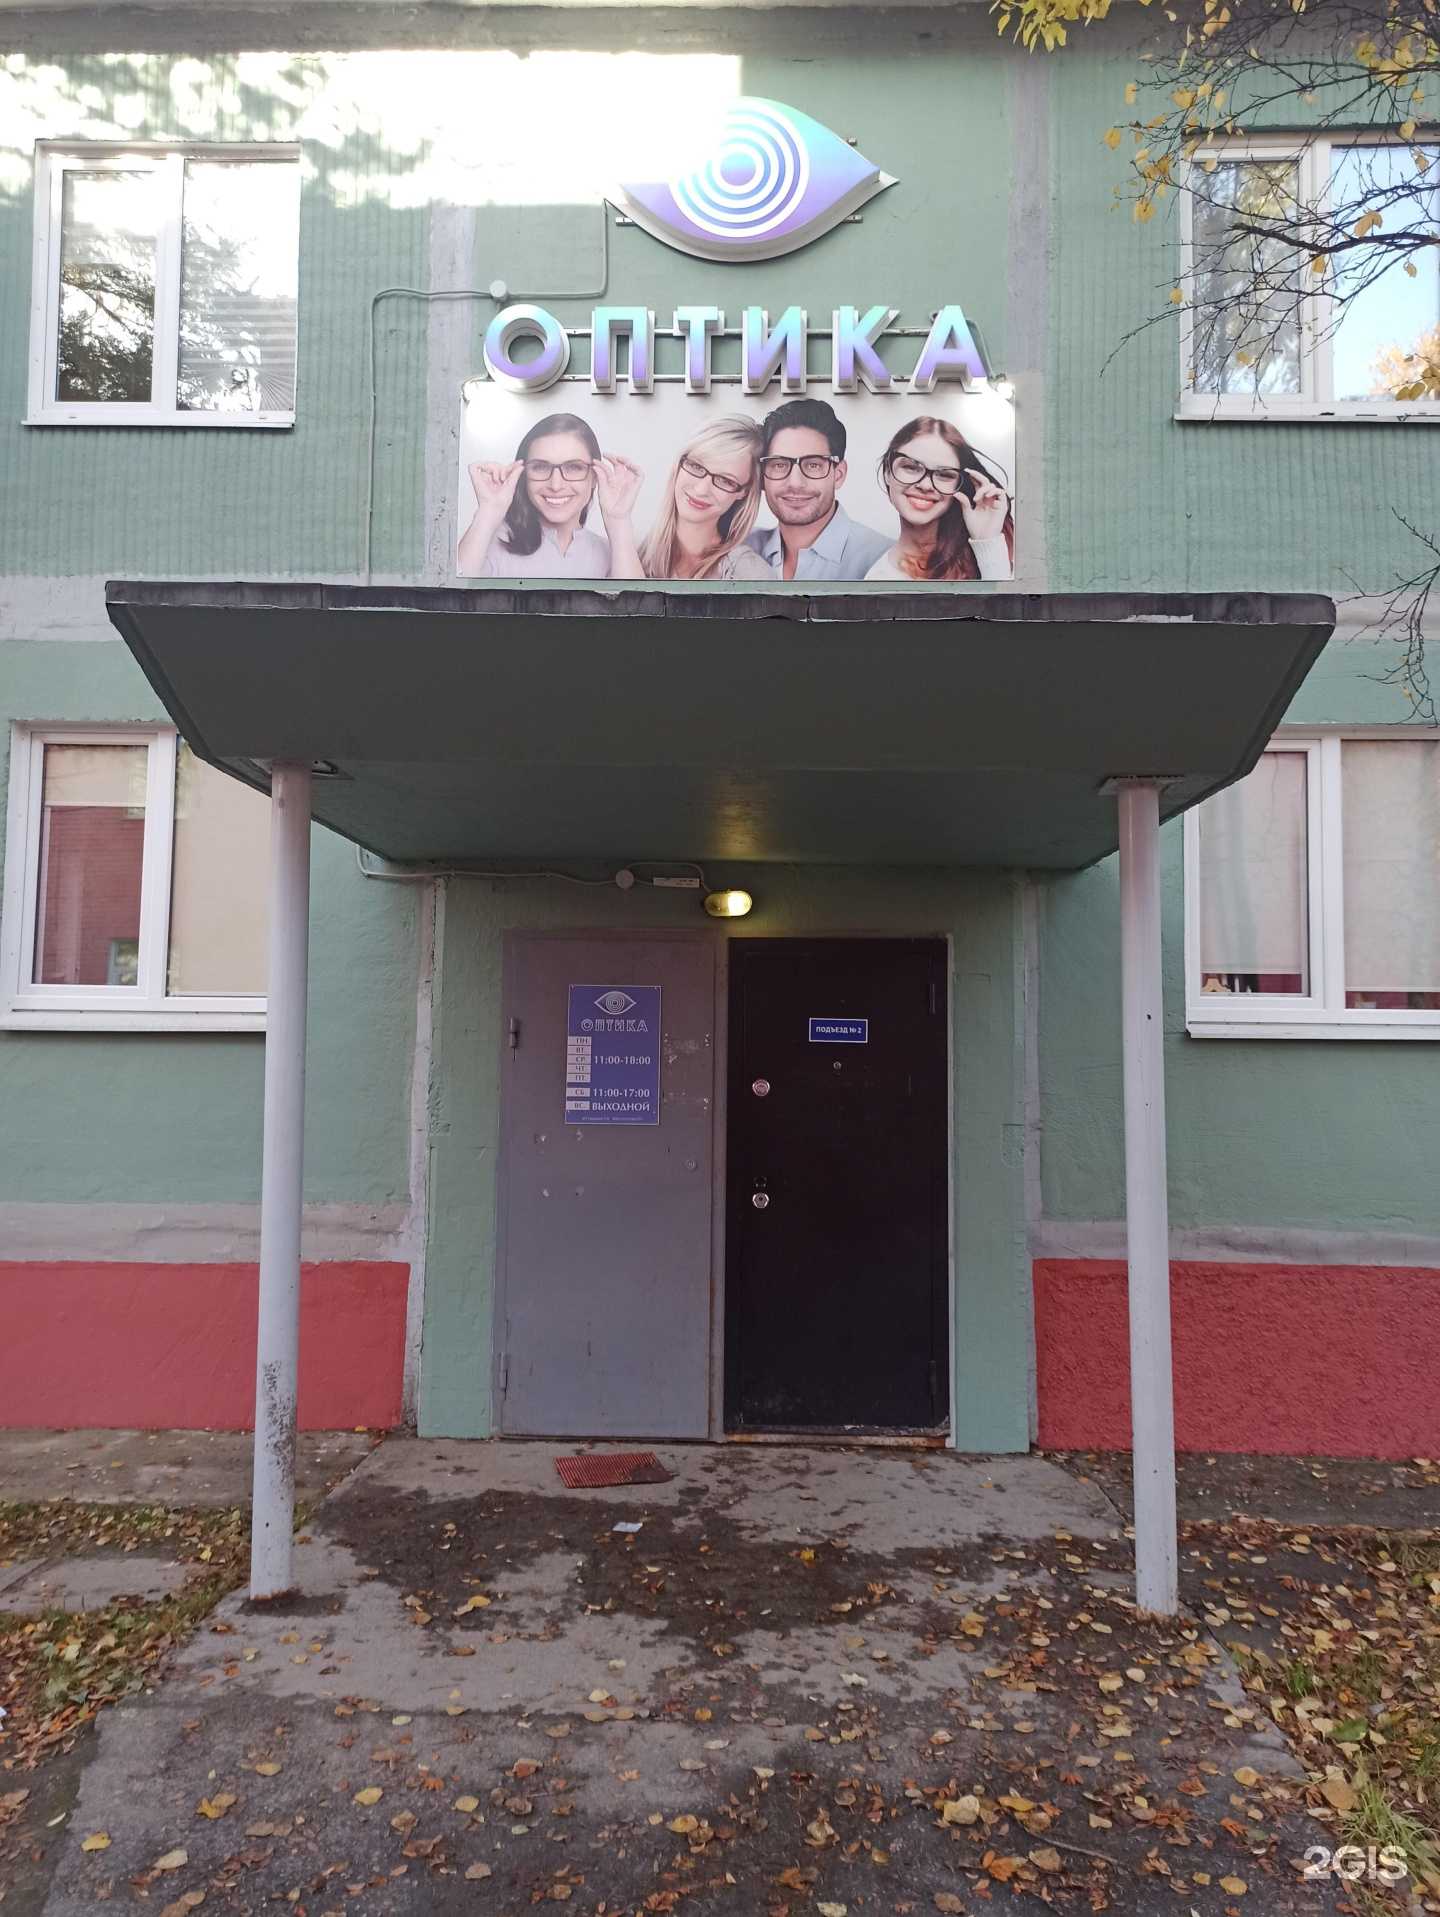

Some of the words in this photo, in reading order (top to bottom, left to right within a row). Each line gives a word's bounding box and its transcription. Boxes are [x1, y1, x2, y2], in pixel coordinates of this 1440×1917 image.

[484, 304, 991, 392] ОПТИКА
[581, 1018, 648, 1032] ОПТИКА
[815, 1026, 848, 1034] ПОДЪЕЗД
[594, 1055, 651, 1065] 11:00-18:00
[593, 1088, 650, 1098] 11:00-17:00
[592, 1102, 650, 1112] ВЫХОДНОЙ
